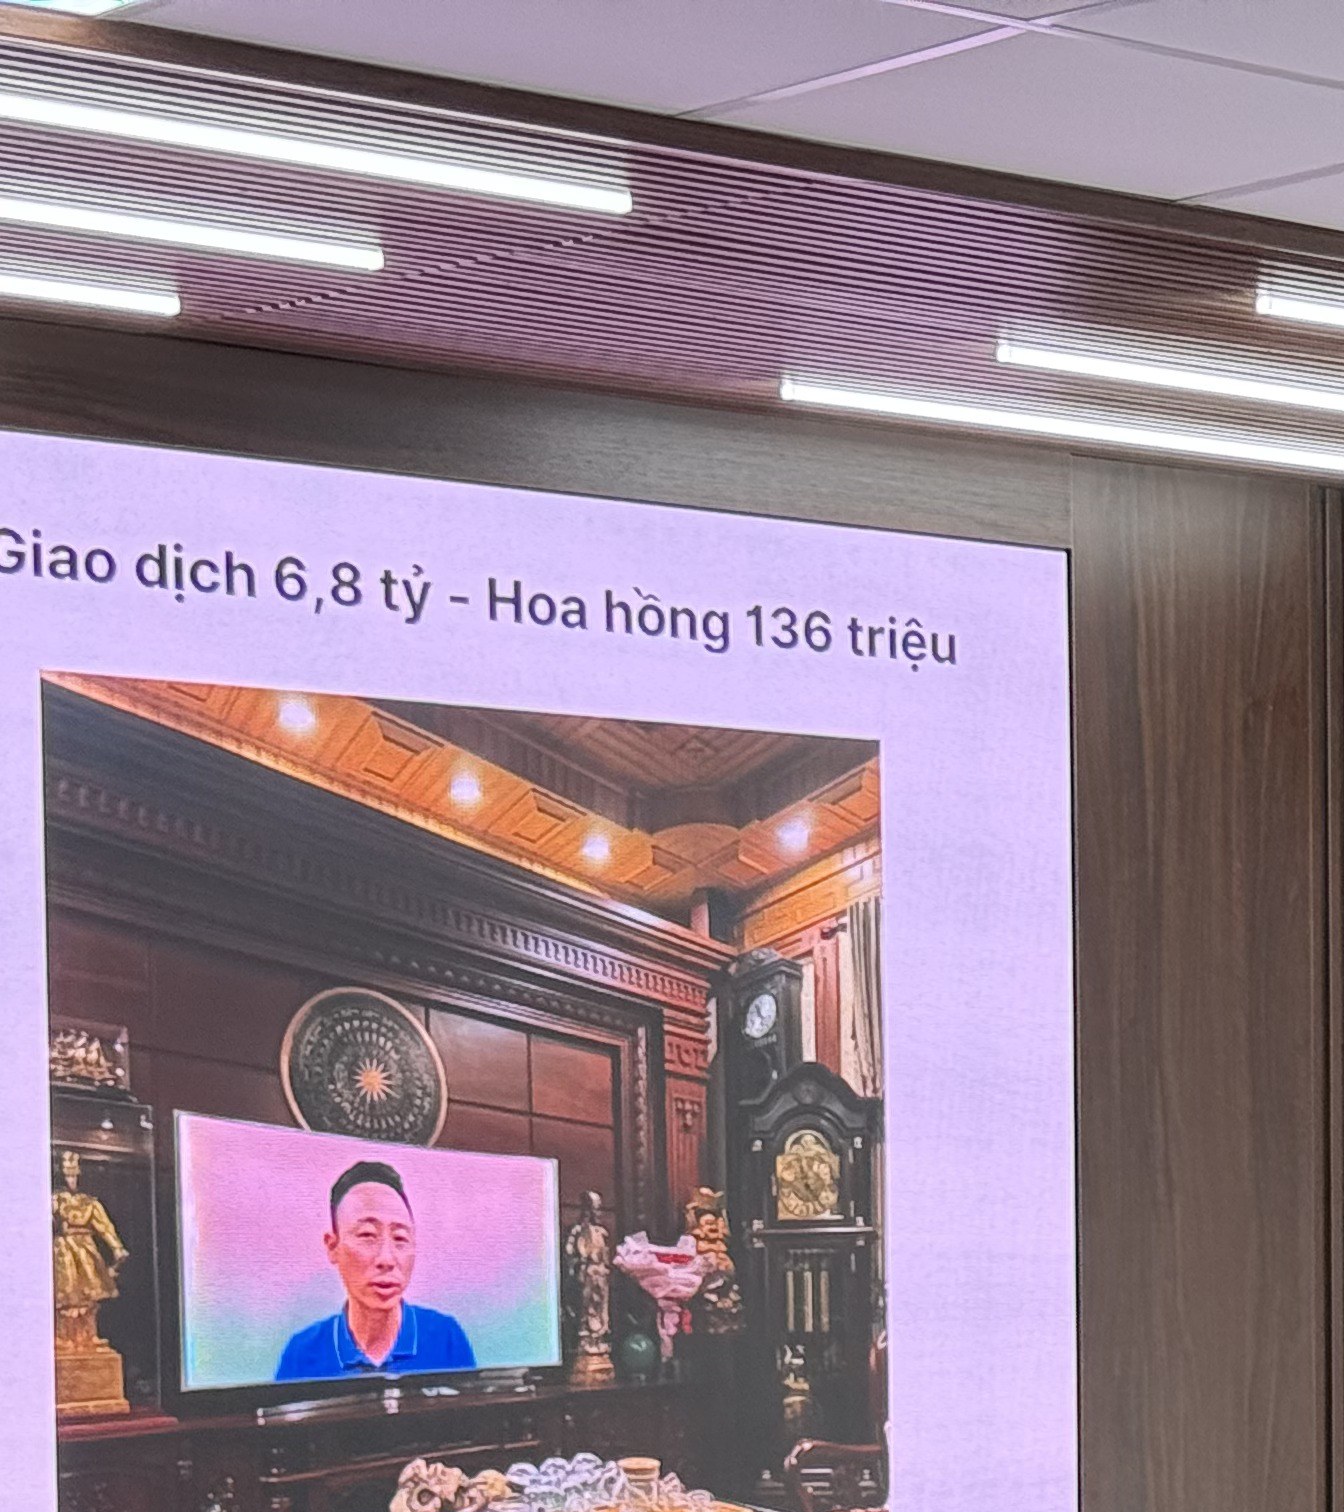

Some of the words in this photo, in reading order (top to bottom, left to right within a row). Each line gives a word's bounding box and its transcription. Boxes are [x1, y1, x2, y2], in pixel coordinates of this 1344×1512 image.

[0, 527, 117, 583] Giao
[136, 543, 256, 603] dịch
[275, 556, 363, 614] 6,8
[380, 564, 431, 625] tỷ
[488, 577, 588, 630] Hoa
[605, 586, 729, 653] hồng
[746, 605, 832, 652] 136
[847, 615, 956, 672] triệu
